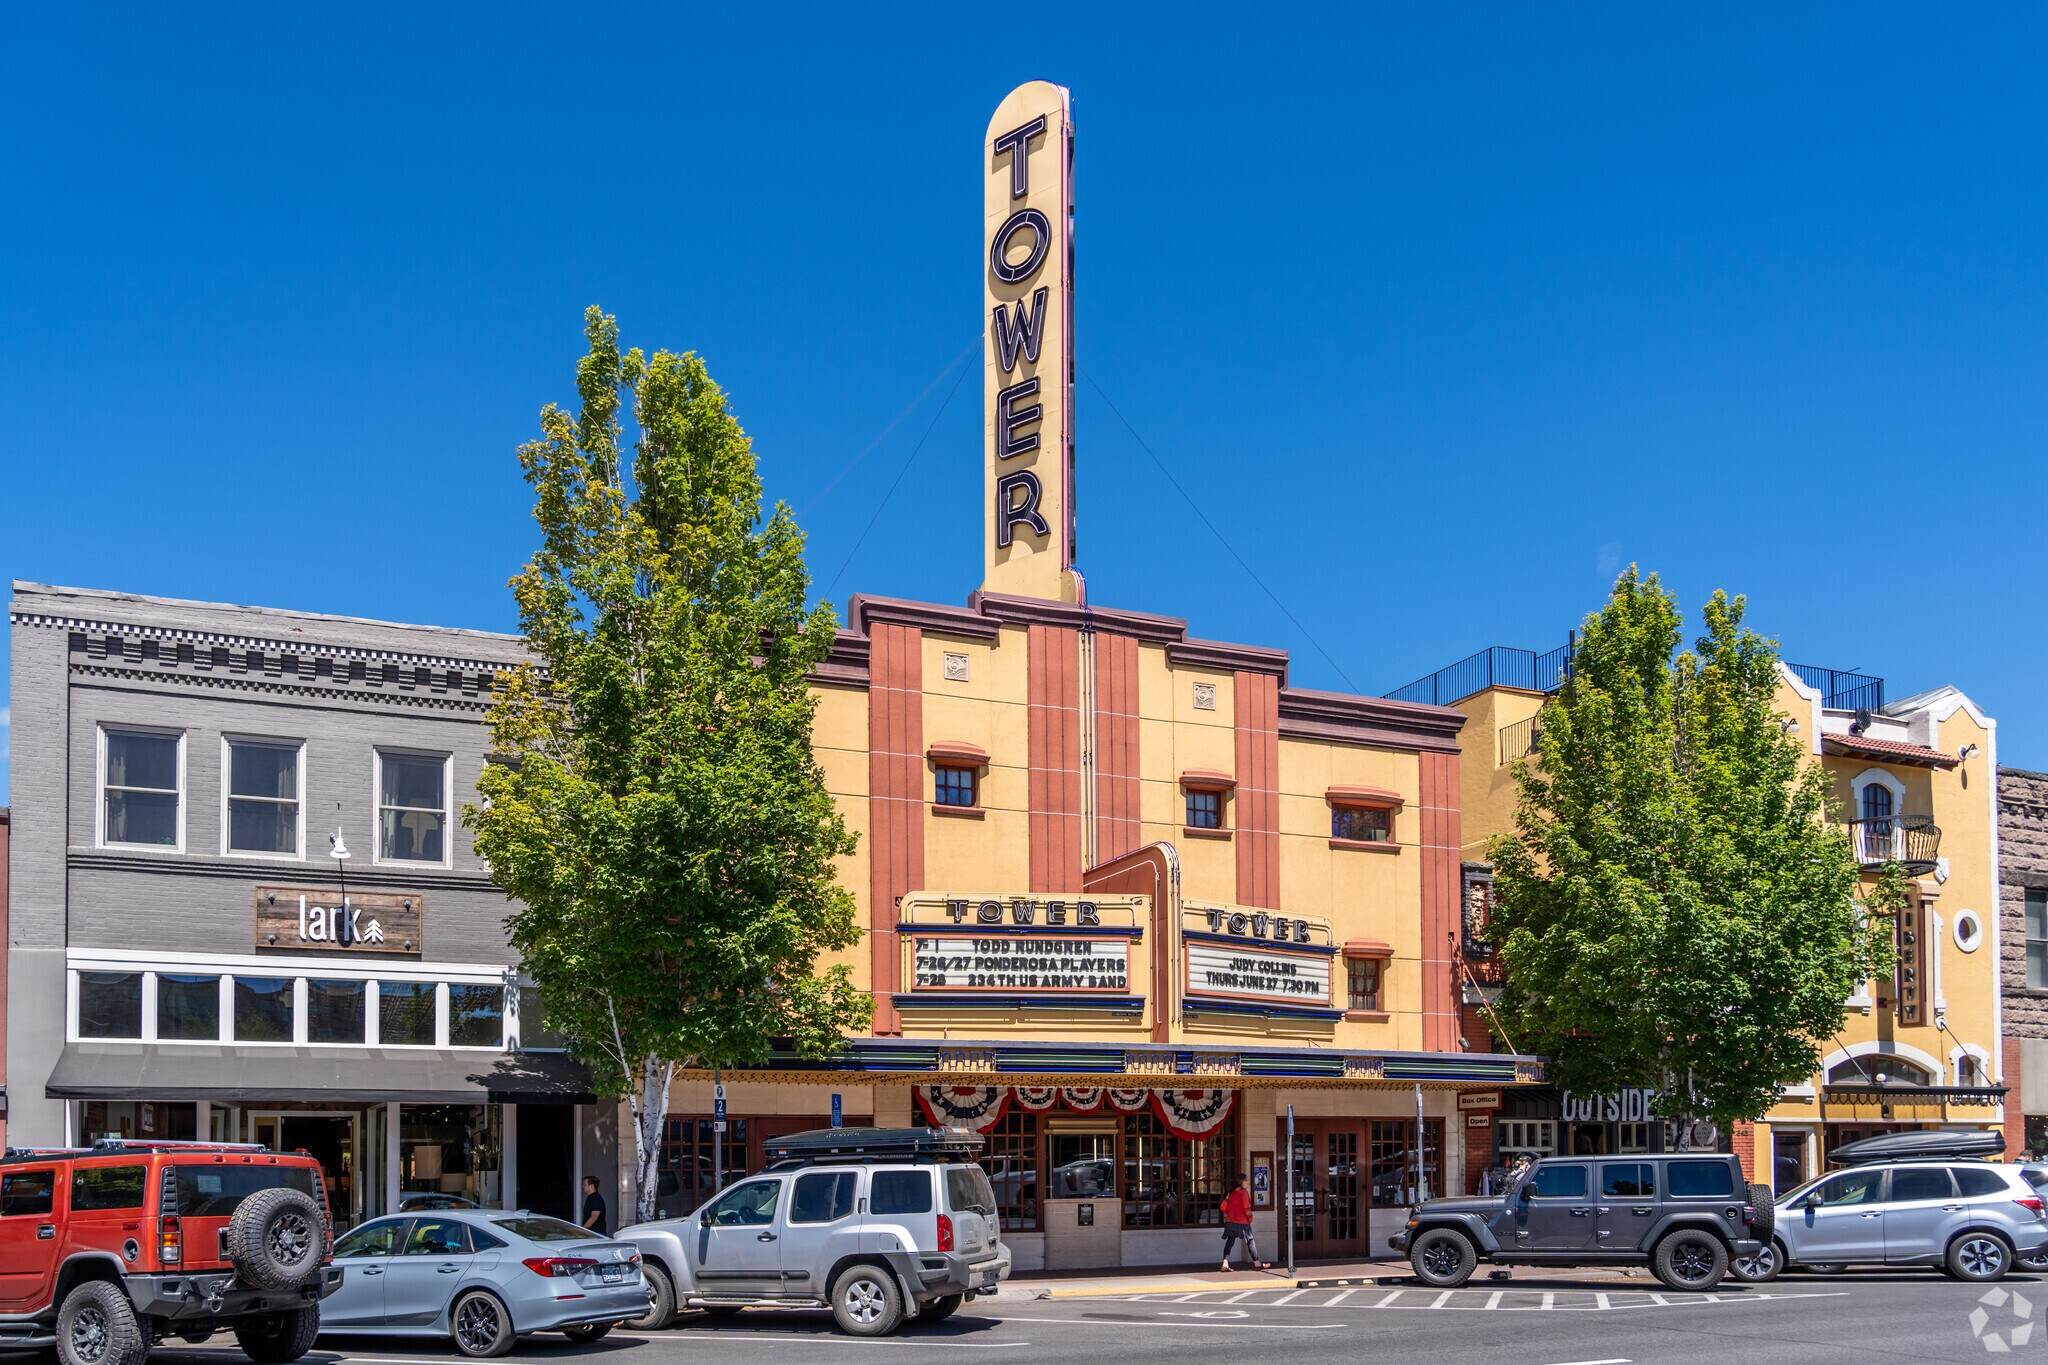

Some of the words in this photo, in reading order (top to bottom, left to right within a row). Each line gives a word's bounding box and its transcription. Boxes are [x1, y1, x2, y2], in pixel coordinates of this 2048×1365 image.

[990, 113, 1052, 550] TOWER
[299, 894, 362, 943] lark
[946, 899, 1101, 925] TOWER
[1205, 908, 1311, 944] TOWER
[972, 940, 1011, 955] TODD
[1015, 940, 1093, 956] RUNDGREN
[915, 956, 972, 972] 7-26/27
[974, 956, 1058, 973] PONDEROSA
[1060, 957, 1127, 973] PLAYERS
[1229, 957, 1256, 973] JUDY
[1257, 960, 1298, 977] COLLINS
[1019, 974, 1038, 988] US
[1040, 974, 1085, 988] ARMY
[1088, 975, 1127, 989] BAND
[1205, 970, 1239, 988] THURS
[1239, 974, 1266, 991] JUNE
[1265, 977, 1279, 992] 27
[1304, 981, 1320, 995] PM
[718, 1100, 723, 1112] 2
